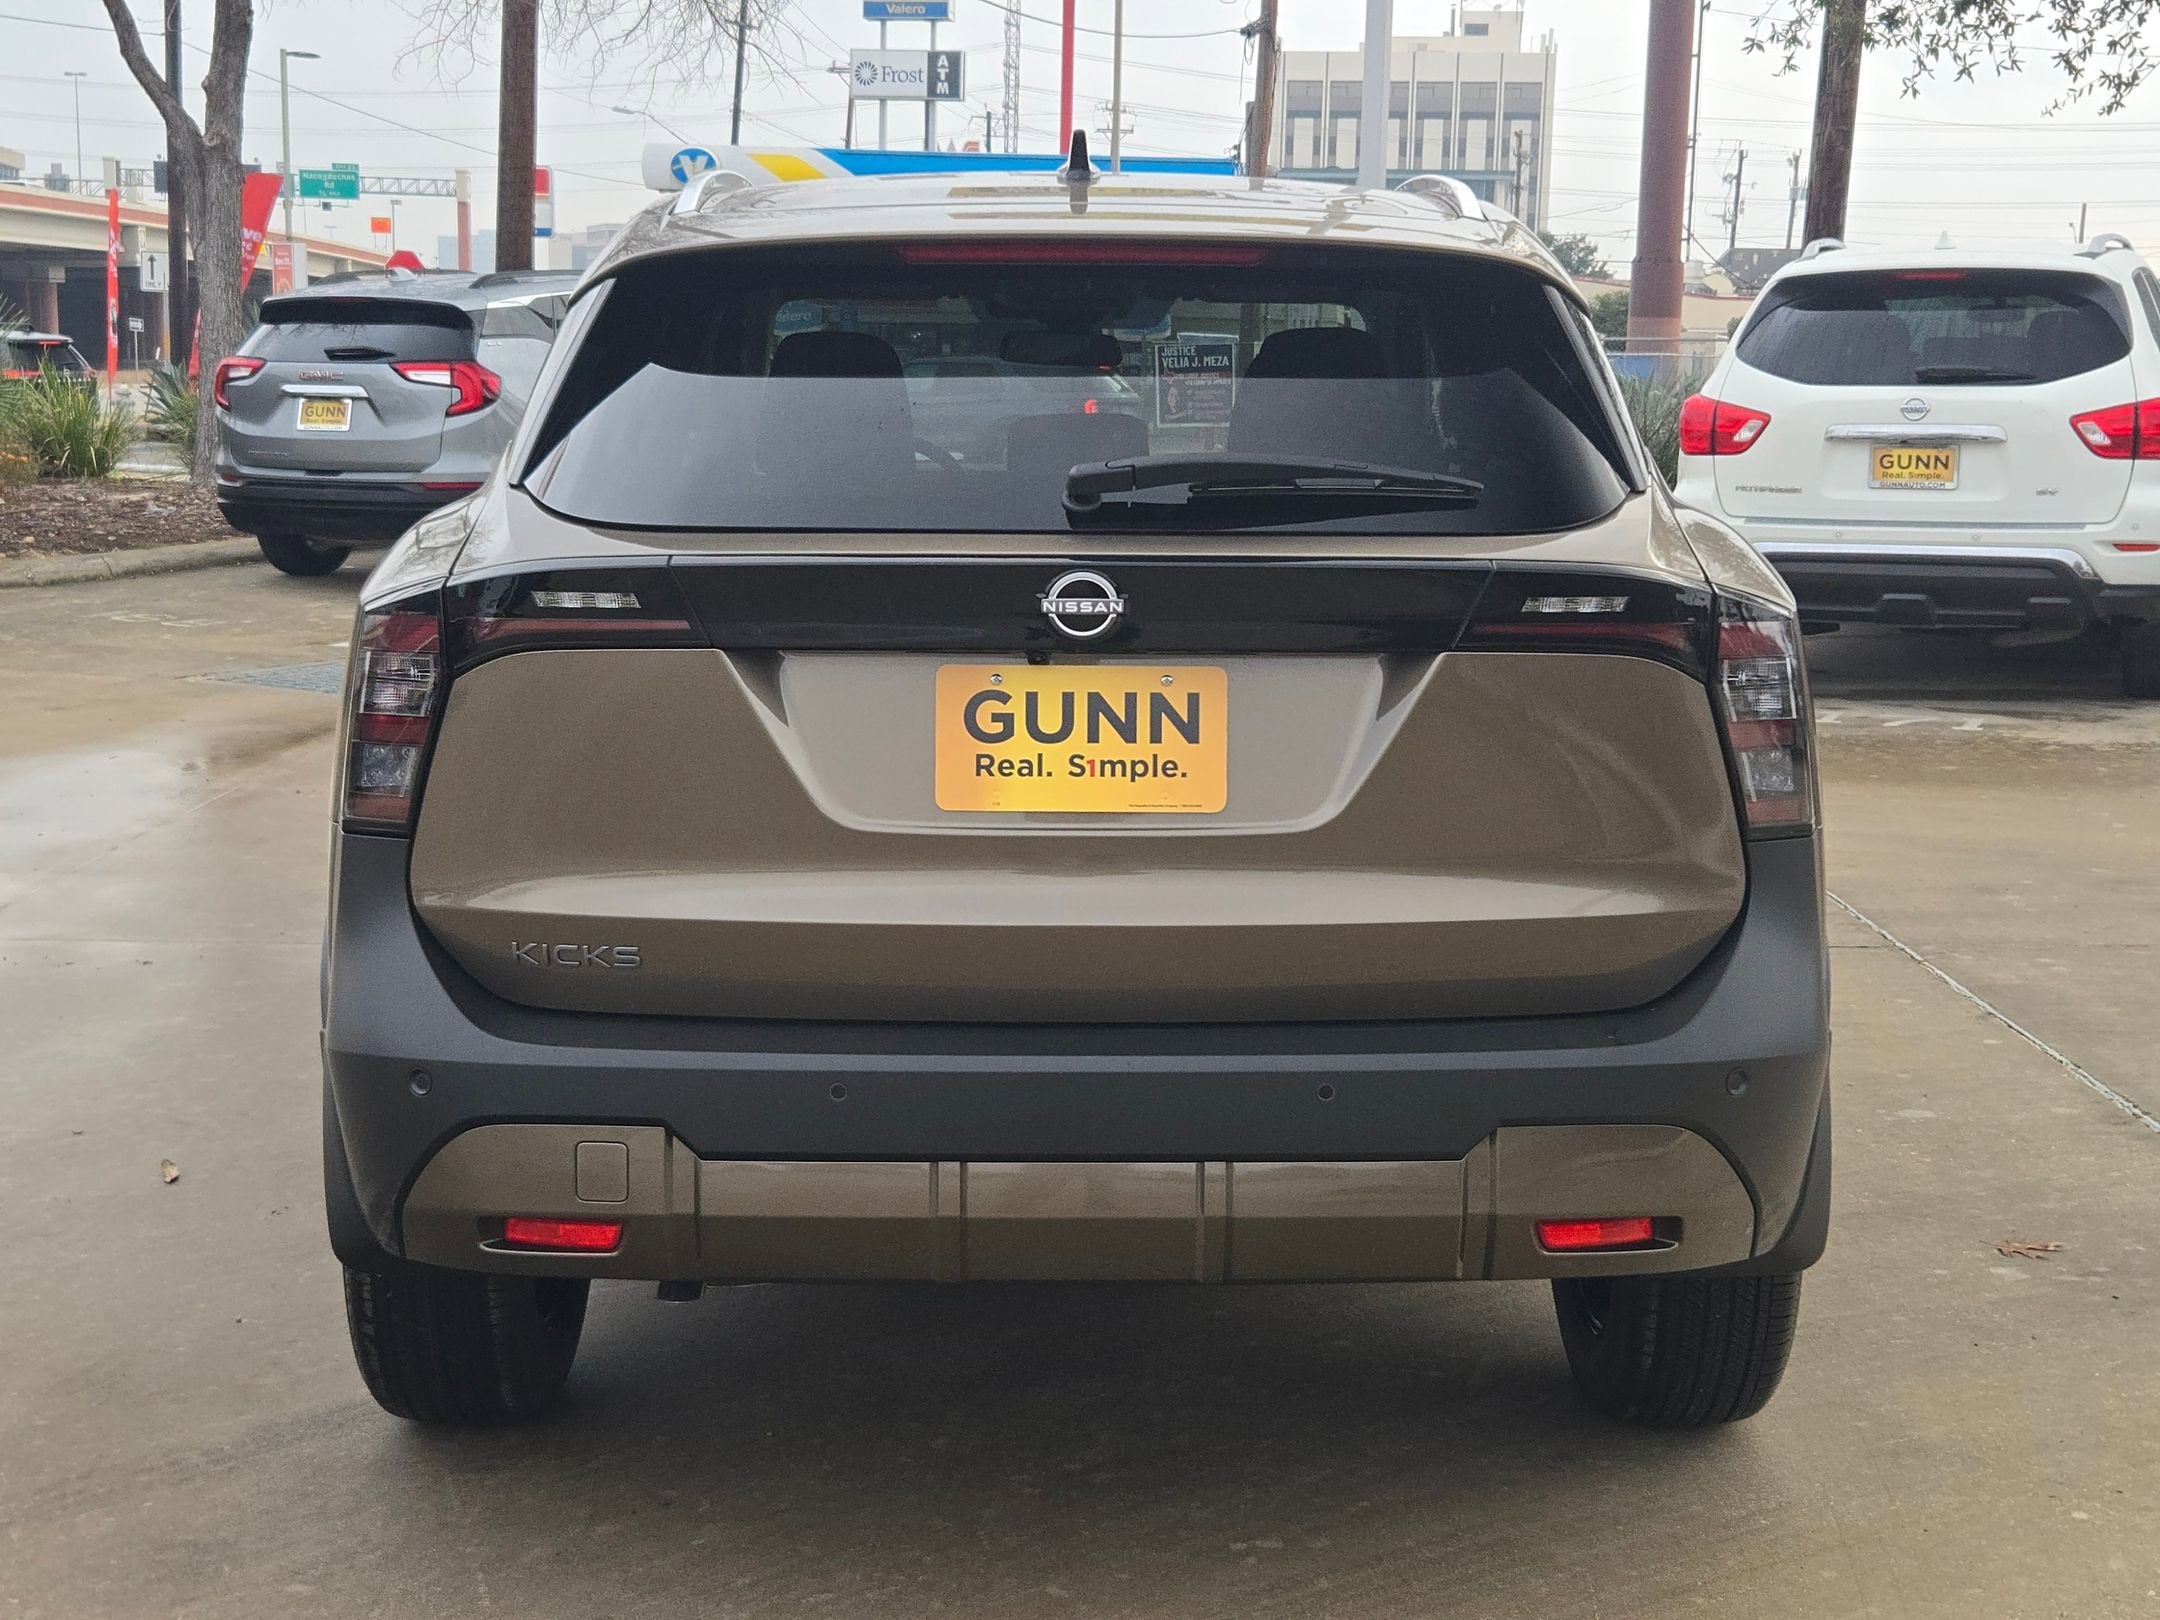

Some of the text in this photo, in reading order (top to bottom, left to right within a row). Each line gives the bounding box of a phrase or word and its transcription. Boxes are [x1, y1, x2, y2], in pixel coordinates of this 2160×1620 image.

[886, 4, 926, 15] Valero
[881, 65, 925, 84] Frost
[936, 54, 950, 95] ATM
[144, 280, 162, 288] ONLY
[1161, 346, 1197, 357] JUSTICE
[1161, 356, 1230, 368] VELIA J. MEZA
[304, 406, 347, 418] GUNN
[1879, 454, 1950, 470] GUNN
[1882, 471, 1906, 479] Real.
[1880, 481, 1946, 489] GUNNAUTO.COM
[1042, 600, 1124, 614] NISSAN
[963, 689, 1200, 745] GUNN
[975, 753, 1053, 778] Real.
[510, 941, 642, 968] KICKS
